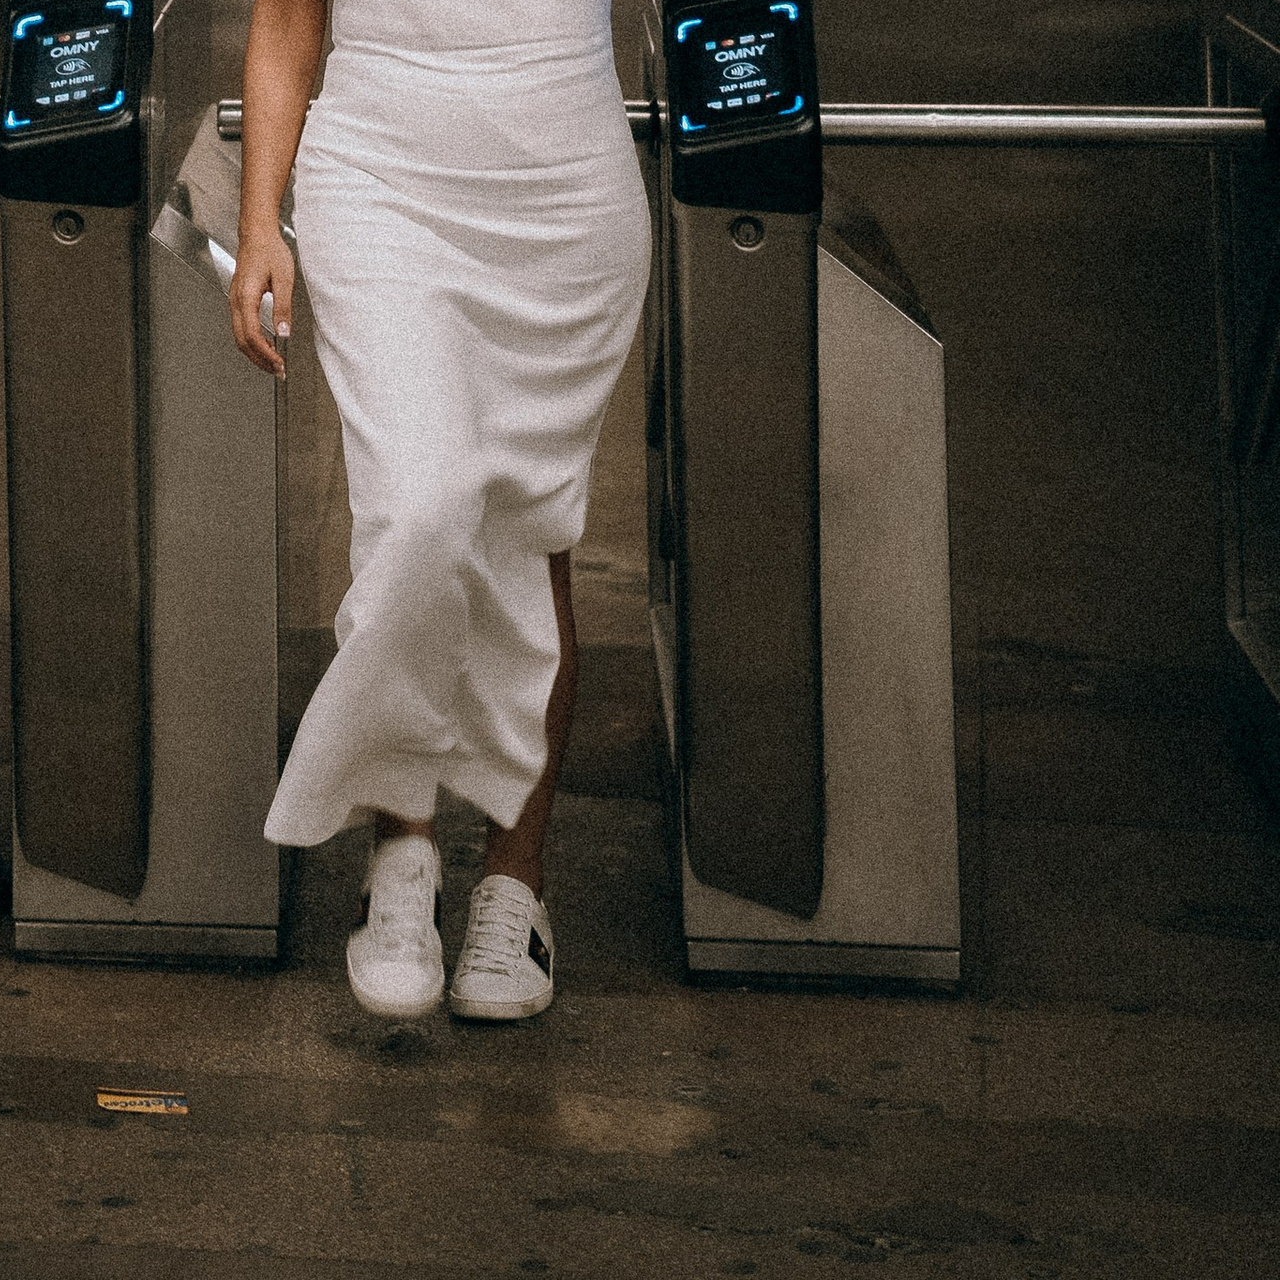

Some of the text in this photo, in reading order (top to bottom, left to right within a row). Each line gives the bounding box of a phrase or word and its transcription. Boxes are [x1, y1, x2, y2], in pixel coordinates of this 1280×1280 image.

[50, 40, 99, 58] OMNY
[714, 44, 767, 62] OMNY
[49, 74, 95, 88] TAP HERE
[719, 78, 767, 93] TAP HERE
